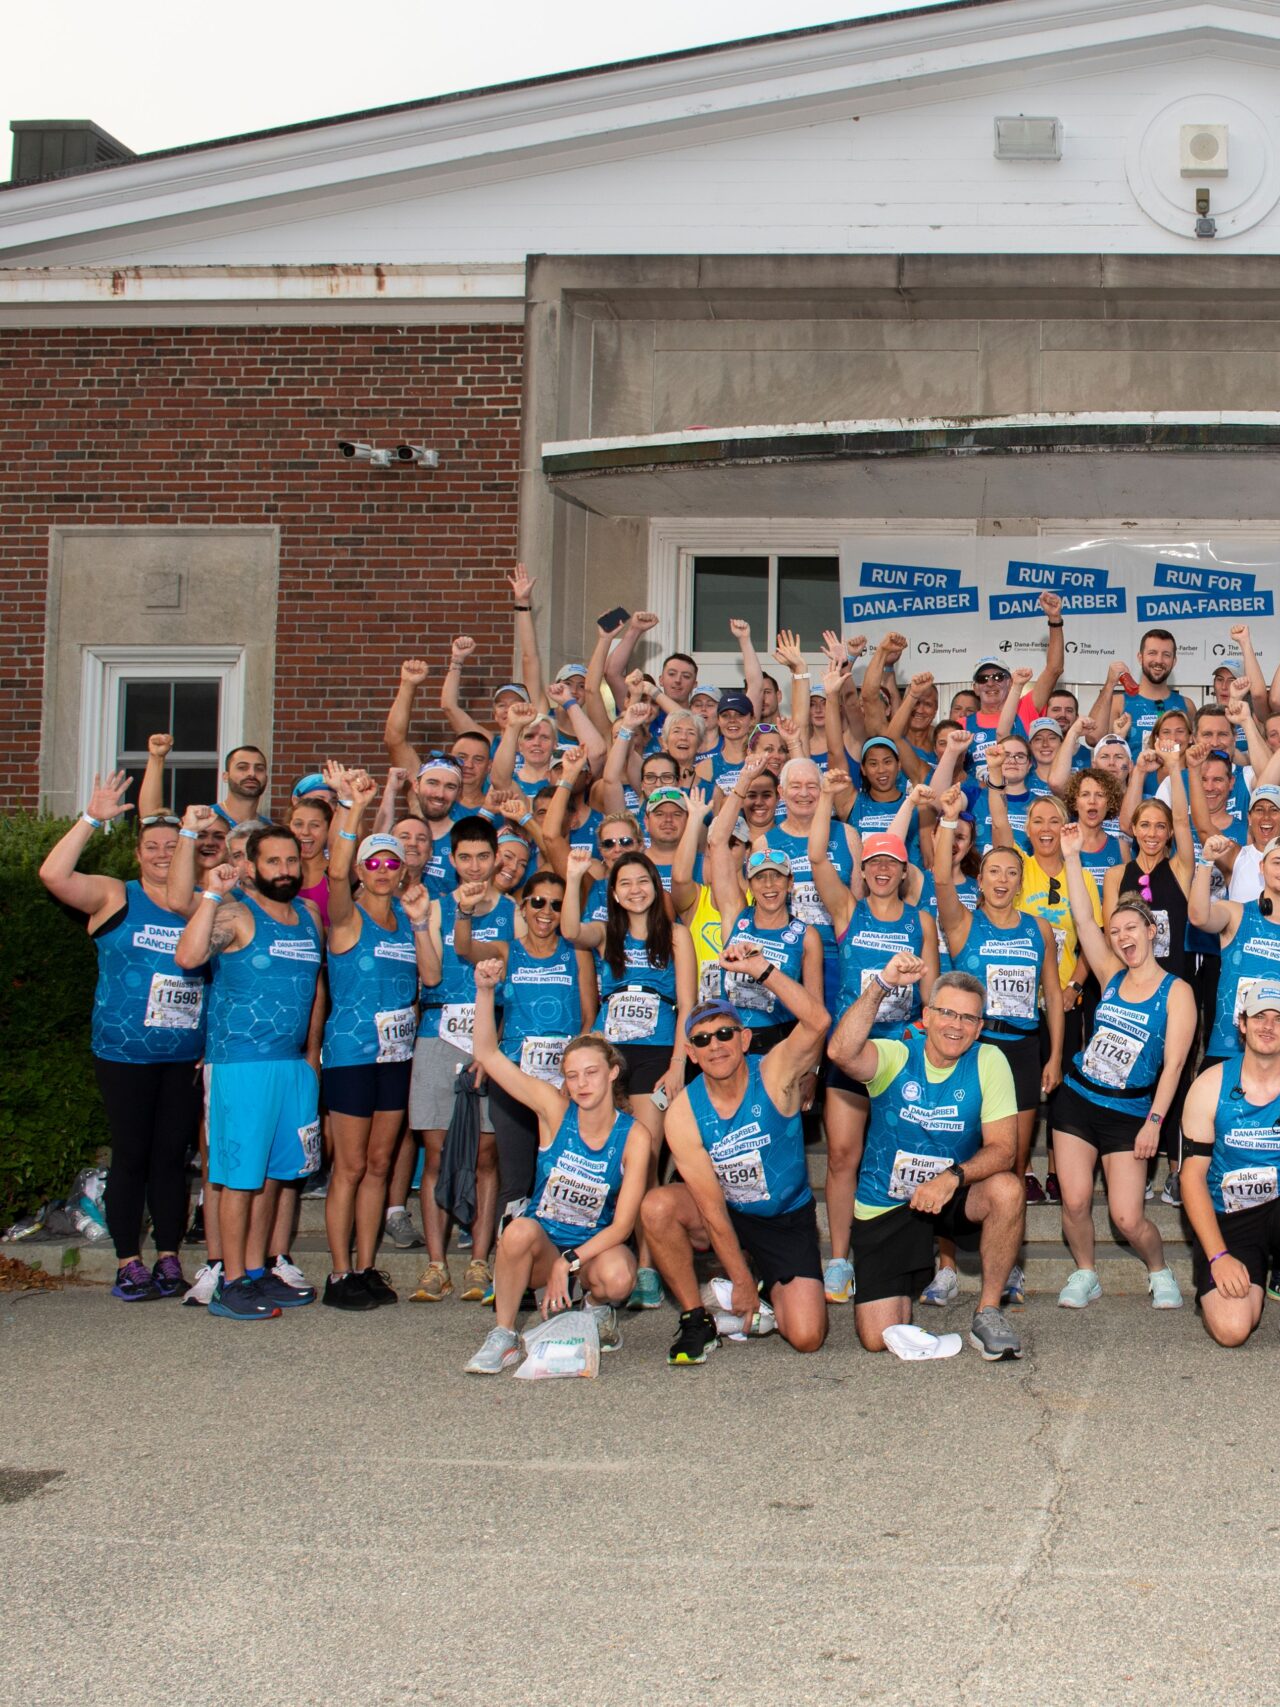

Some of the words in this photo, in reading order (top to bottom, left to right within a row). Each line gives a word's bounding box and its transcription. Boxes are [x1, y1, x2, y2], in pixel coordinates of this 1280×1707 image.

[871, 568, 908, 585] RUN
[913, 572, 948, 589] FOR
[1018, 567, 1055, 585] RUN
[1060, 572, 1095, 588] FOR
[1166, 570, 1202, 588] RUN
[1208, 575, 1242, 592] FOR
[852, 593, 970, 618] DANA-FARBER
[998, 594, 1118, 615] DANAARBER
[1146, 597, 1265, 617] DANA-FARBER
[931, 647, 951, 655] Jimmy
[854, 938, 880, 948] CANCER
[1008, 948, 1037, 959] INSTITUTE
[1244, 945, 1269, 957] CANCER
[539, 975, 571, 984] INSTITUTE
[998, 968, 1025, 977] Sophia
[163, 979, 194, 988] Melissa
[993, 979, 1030, 993] 11761
[157, 989, 199, 1005] 11598
[620, 994, 647, 1004] Ashley
[612, 1005, 653, 1020] 11555
[384, 1022, 415, 1040] 11604
[1117, 1019, 1148, 1040] INSTITUTE
[1106, 1032, 1128, 1047] ERICA
[1094, 1040, 1132, 1065] 11743
[929, 1121, 963, 1130] INSTITUTE
[734, 1136, 770, 1150] INSTITUTE
[1226, 1137, 1254, 1147] CANCER
[717, 1160, 744, 1171] Steve
[911, 1157, 935, 1168] Brian
[720, 1166, 759, 1184] 1594
[1237, 1172, 1258, 1181] Jake
[558, 1174, 598, 1194] Callahan
[1227, 1182, 1273, 1195] 11706
[552, 1184, 599, 1209] 11582
